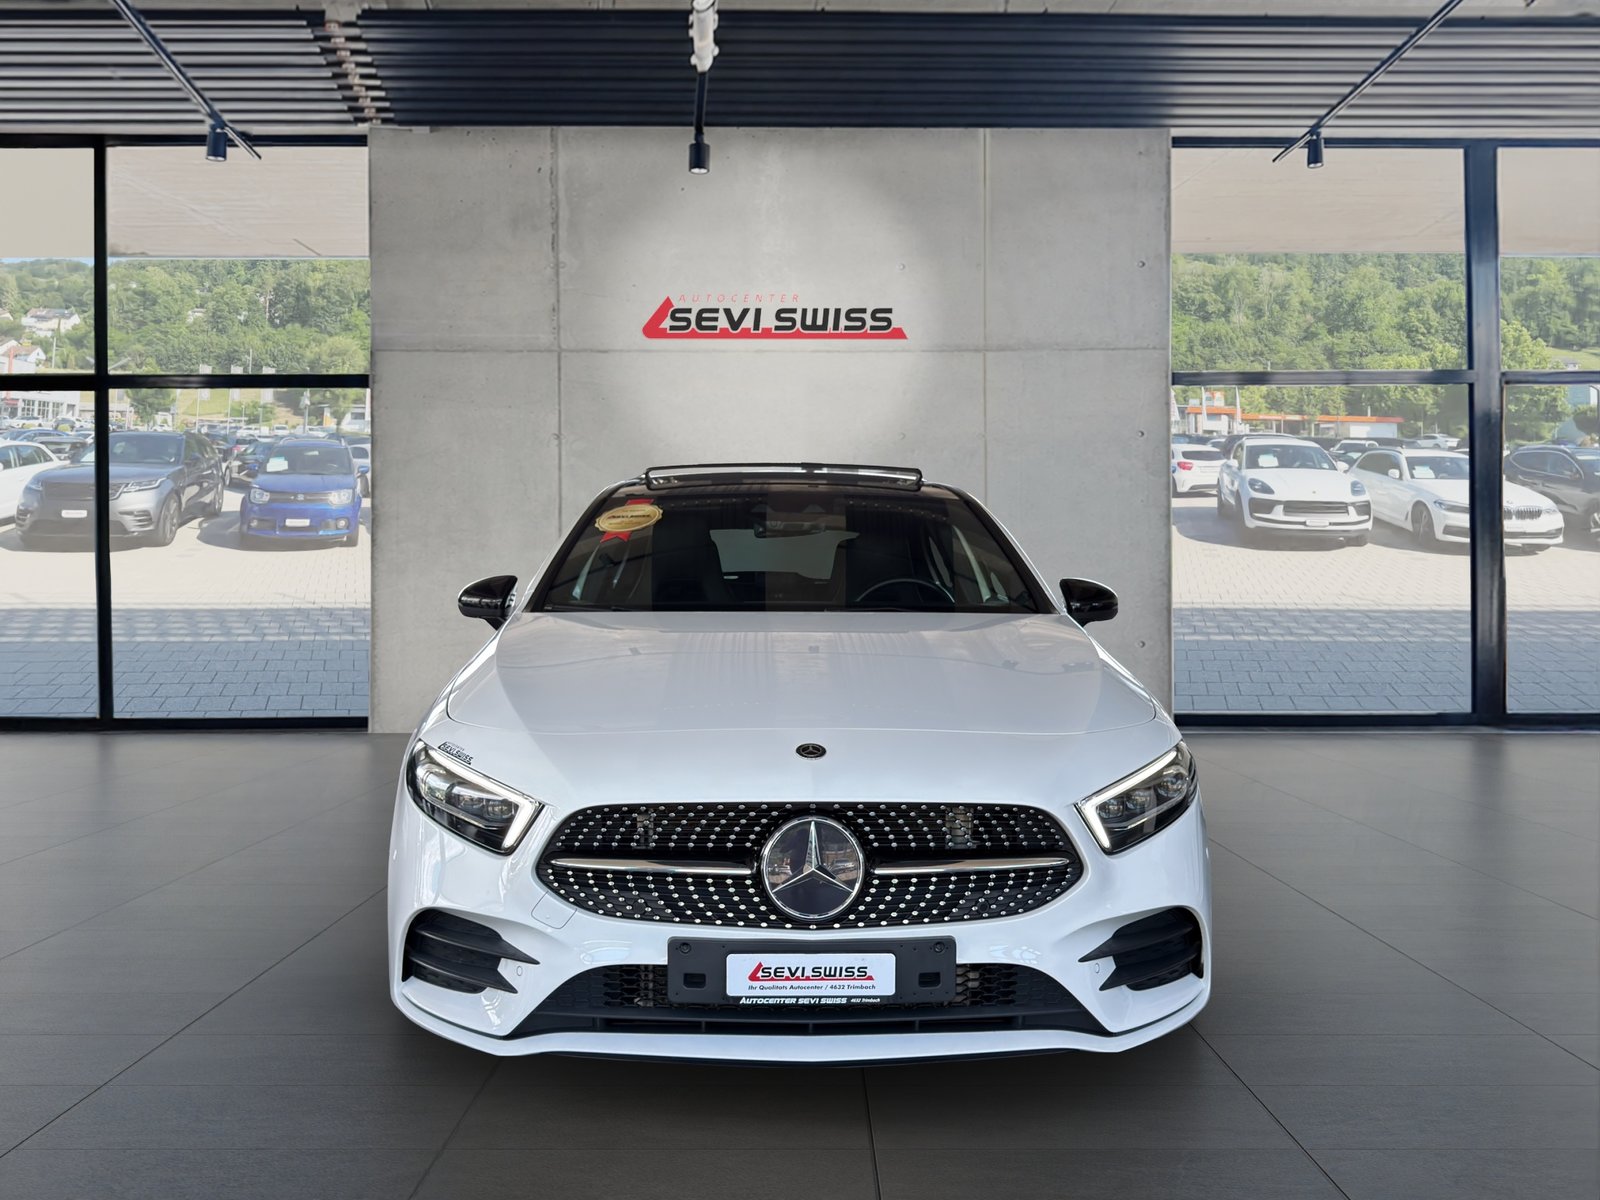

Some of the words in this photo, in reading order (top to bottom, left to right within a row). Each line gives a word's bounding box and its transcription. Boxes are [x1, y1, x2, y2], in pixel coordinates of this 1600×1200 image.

[679, 293, 800, 303] AUTOCENTER
[669, 307, 762, 331] SEVI
[774, 307, 893, 331] SWISS
[761, 966, 805, 977] SEVI
[811, 966, 868, 977] SWISS
